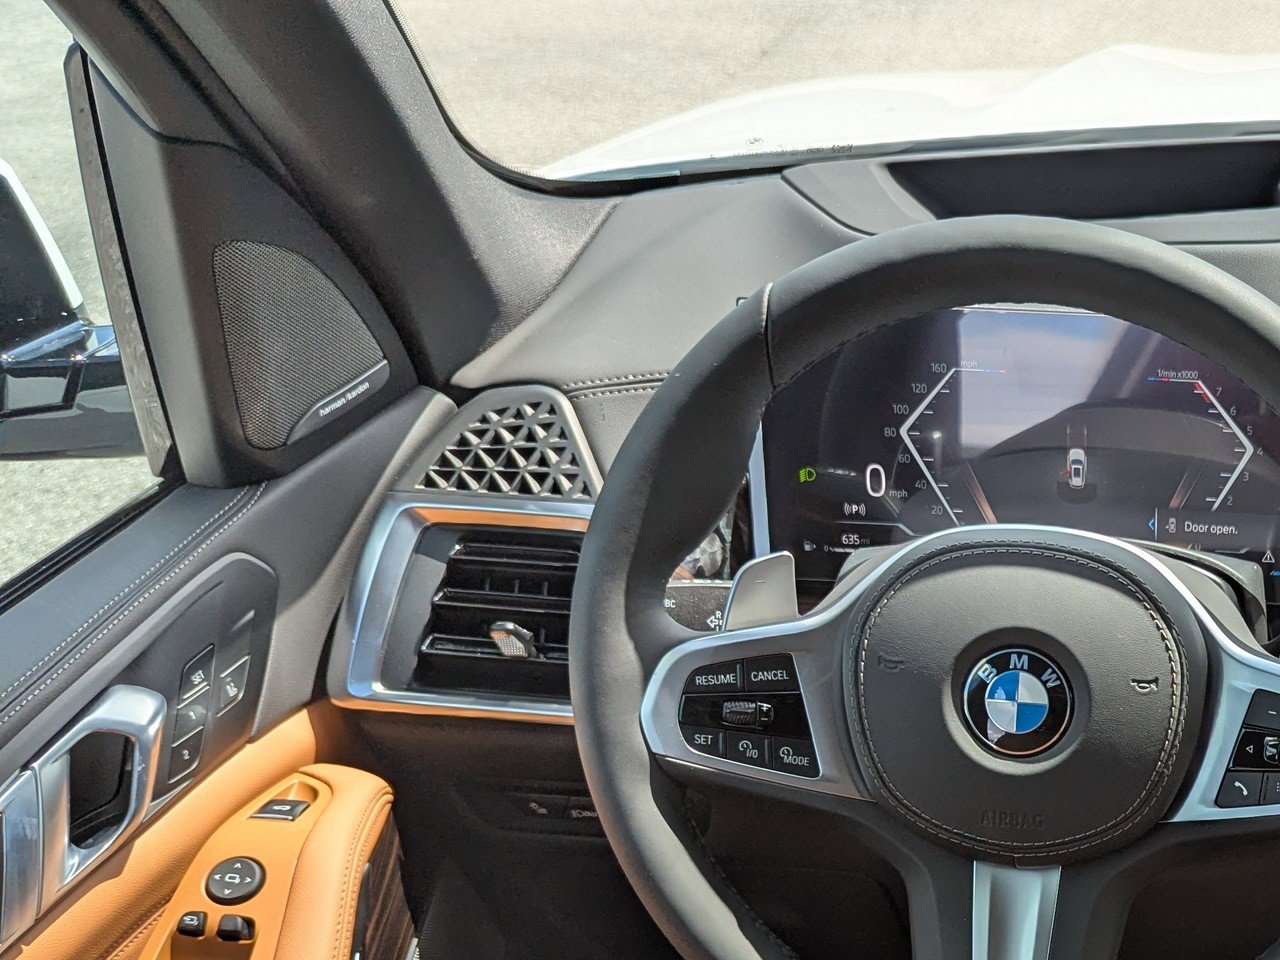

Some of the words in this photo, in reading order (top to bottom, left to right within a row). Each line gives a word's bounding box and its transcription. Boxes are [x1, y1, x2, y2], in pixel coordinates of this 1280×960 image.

[930, 363, 947, 374] 160
[911, 383, 928, 394] 120
[1215, 387, 1222, 397] 7
[892, 404, 910, 415] 100
[1230, 406, 1237, 416] 6
[884, 427, 897, 437] 80
[1246, 426, 1253, 435] 5
[1256, 446, 1264, 457] 4
[898, 453, 911, 464] 60
[865, 464, 886, 498] 0
[1243, 472, 1250, 482] 3
[915, 480, 928, 490] 40
[889, 488, 908, 499] mph
[1226, 496, 1233, 506] 2
[931, 505, 944, 515] 20
[1184, 521, 1209, 533] Door
[1211, 523, 1239, 536] open.
[842, 534, 860, 546] 635
[751, 670, 790, 681] CANCEL
[978, 653, 1061, 688] BMW
[190, 669, 205, 685] SET
[695, 673, 737, 686] RESUME
[694, 734, 713, 745] SET
[182, 749, 190, 760] 2
[783, 755, 810, 766] MODE
